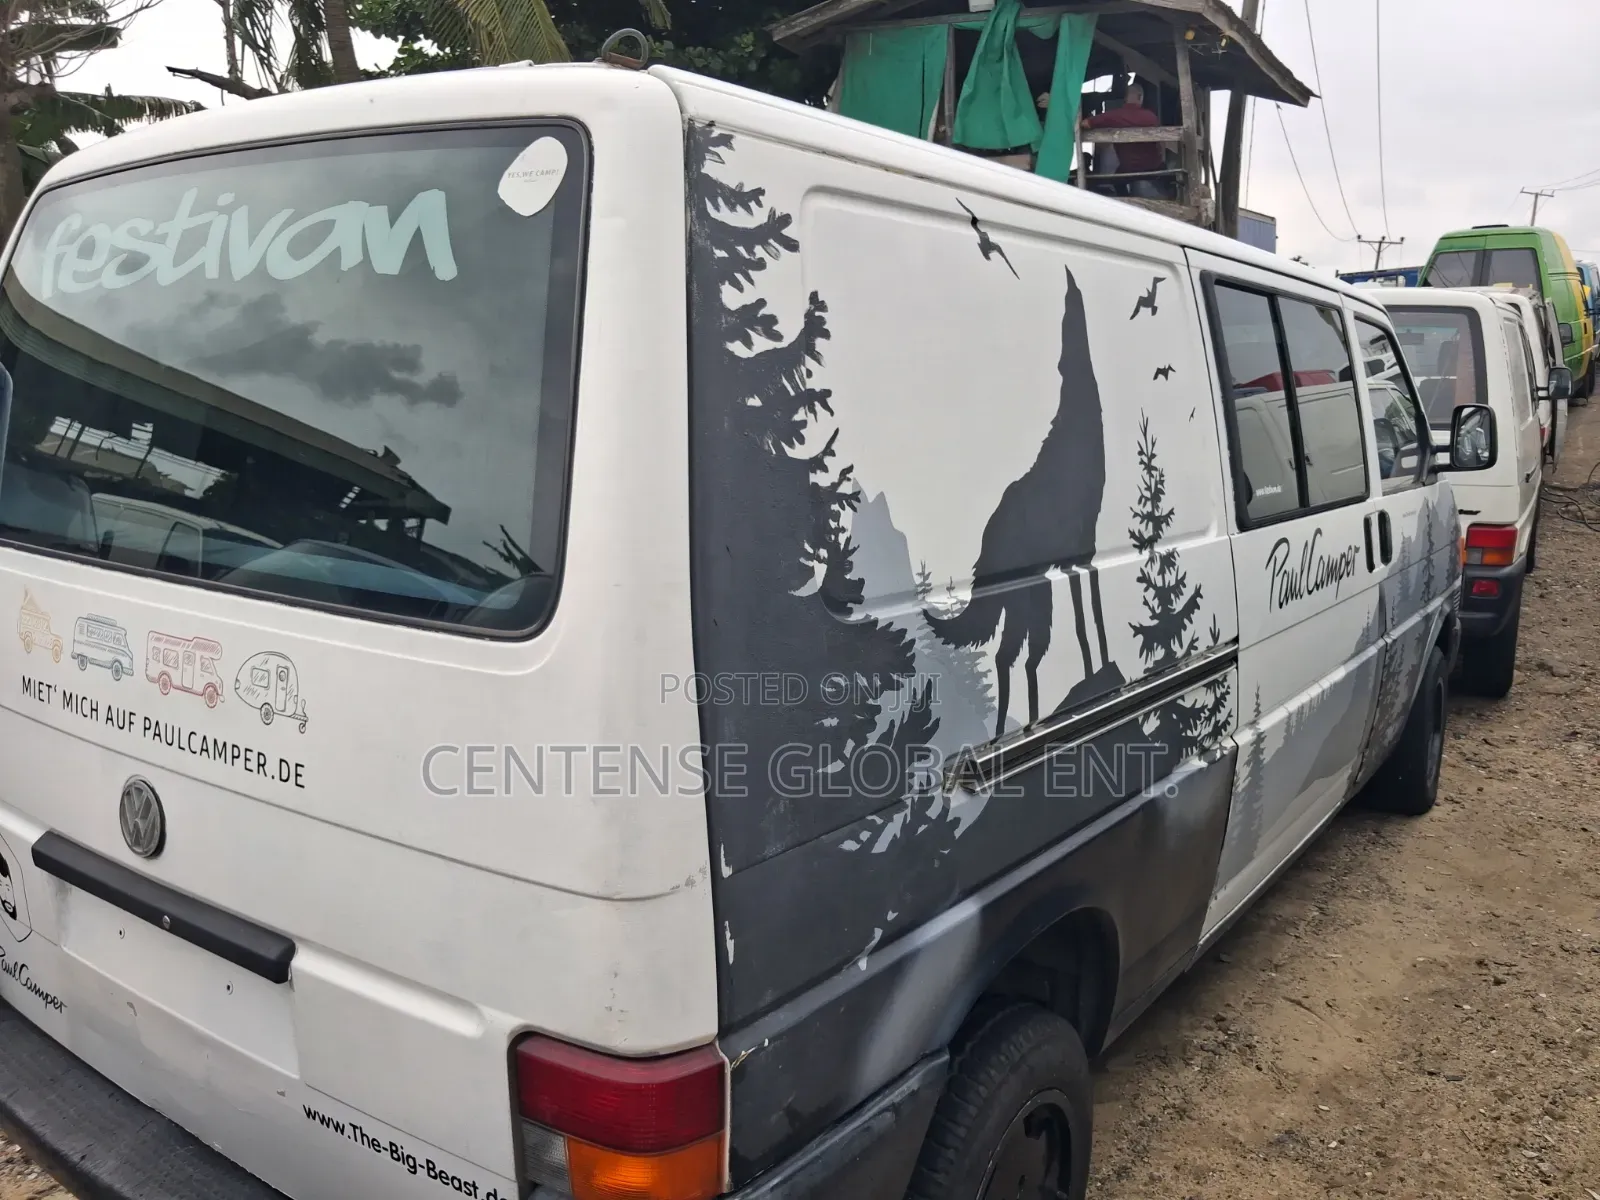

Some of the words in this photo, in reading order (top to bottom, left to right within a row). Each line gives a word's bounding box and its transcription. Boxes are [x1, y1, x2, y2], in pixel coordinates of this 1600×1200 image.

[41, 186, 458, 300] festivan
[62, 689, 99, 722] MICH
[105, 704, 137, 733] AUF
[143, 716, 306, 790] PAULCAMPER.DE
[302, 1104, 508, 1200] www.The-Big-Beast.d
